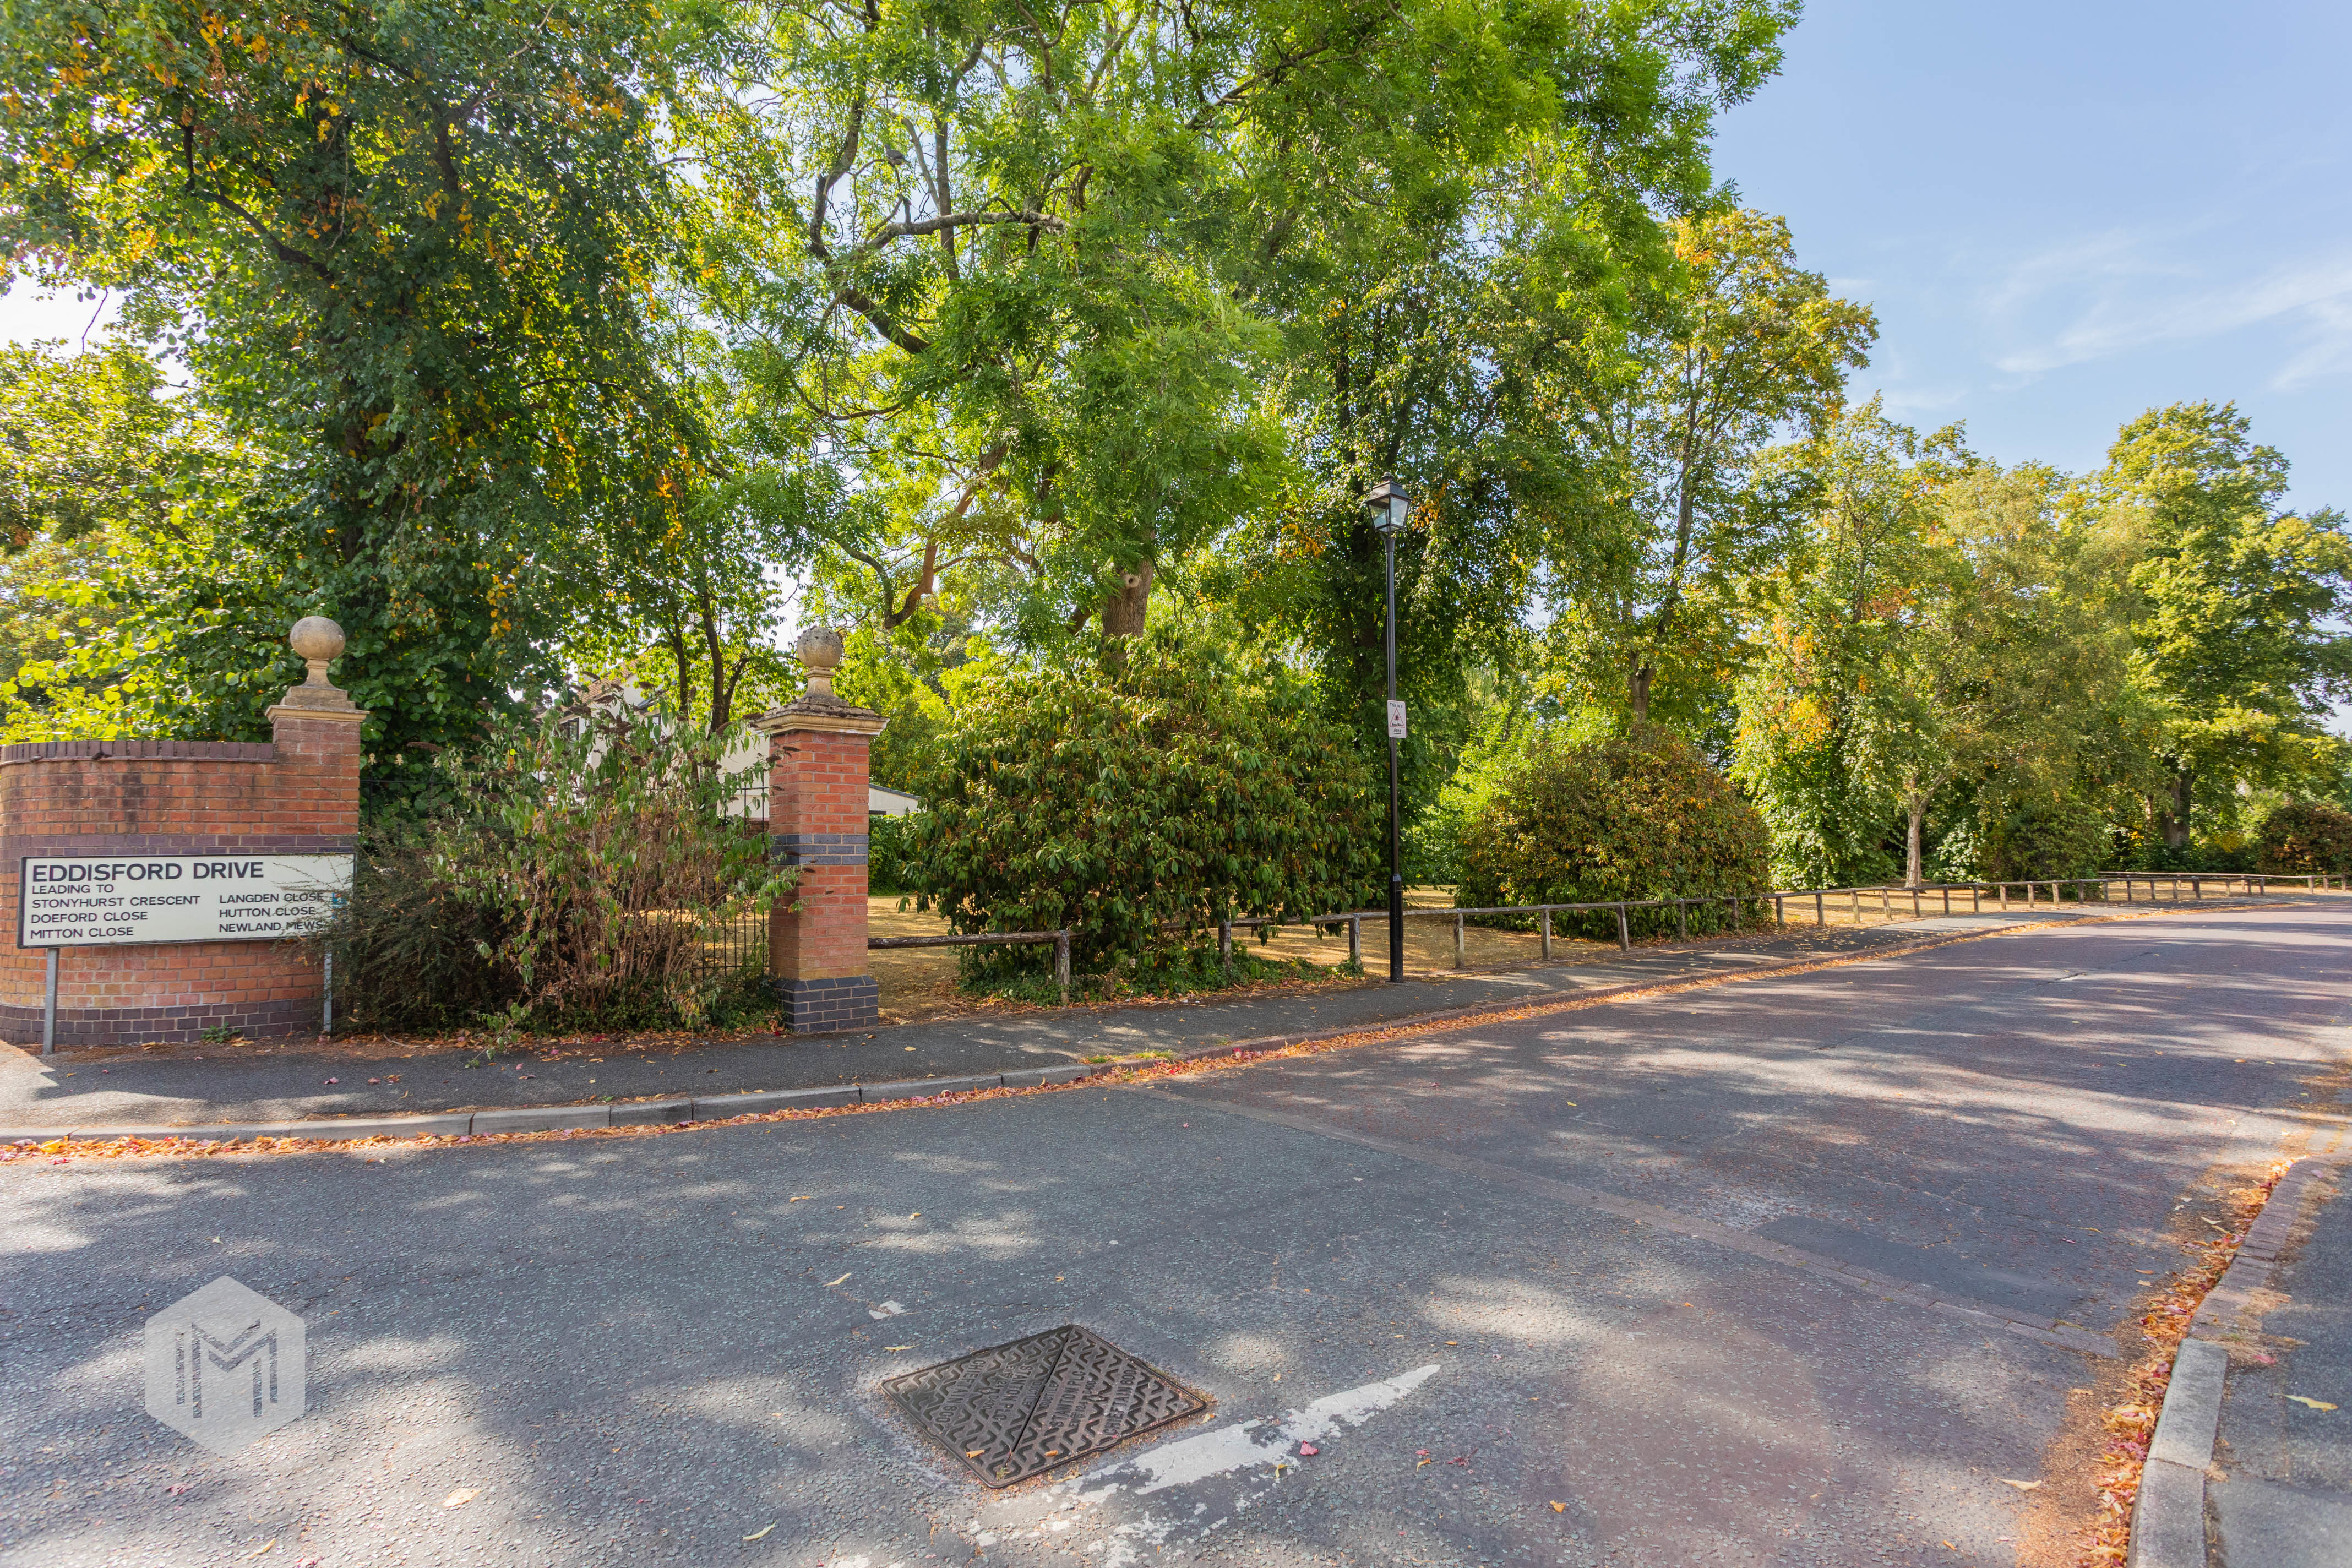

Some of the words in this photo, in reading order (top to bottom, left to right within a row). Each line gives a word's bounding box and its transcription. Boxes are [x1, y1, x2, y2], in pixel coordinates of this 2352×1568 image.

[33, 863, 182, 881] EDDISFORD
[193, 862, 264, 879] DRIVE
[32, 884, 91, 894] LEADING
[96, 884, 114, 893] TO
[220, 894, 279, 903] LANGDEN
[284, 892, 324, 902] CLOSE
[32, 897, 124, 908] STONYHURST
[130, 896, 200, 906] CRESCENT
[31, 913, 97, 923] DOEFORD
[103, 911, 148, 921] CLOSE
[219, 908, 271, 918] HUTTON
[275, 907, 315, 916] CLOSE
[30, 928, 83, 939] MITTON
[89, 927, 134, 937] CLOSE
[219, 922, 281, 932] NEWLAND
[946, 1359, 986, 1403] CHIEFTAIN
[1002, 1365, 1033, 1401] STANTON
[1022, 1382, 1042, 1406] DUCTILE
[1049, 1387, 1080, 1428] STANTON
[1067, 1370, 1086, 1385] PLC
[1102, 1387, 1133, 1435] CHIEFTAIN
[1120, 1369, 1137, 1385] 600
[935, 1405, 958, 1423] 600
[992, 1403, 1014, 1421] PLC
